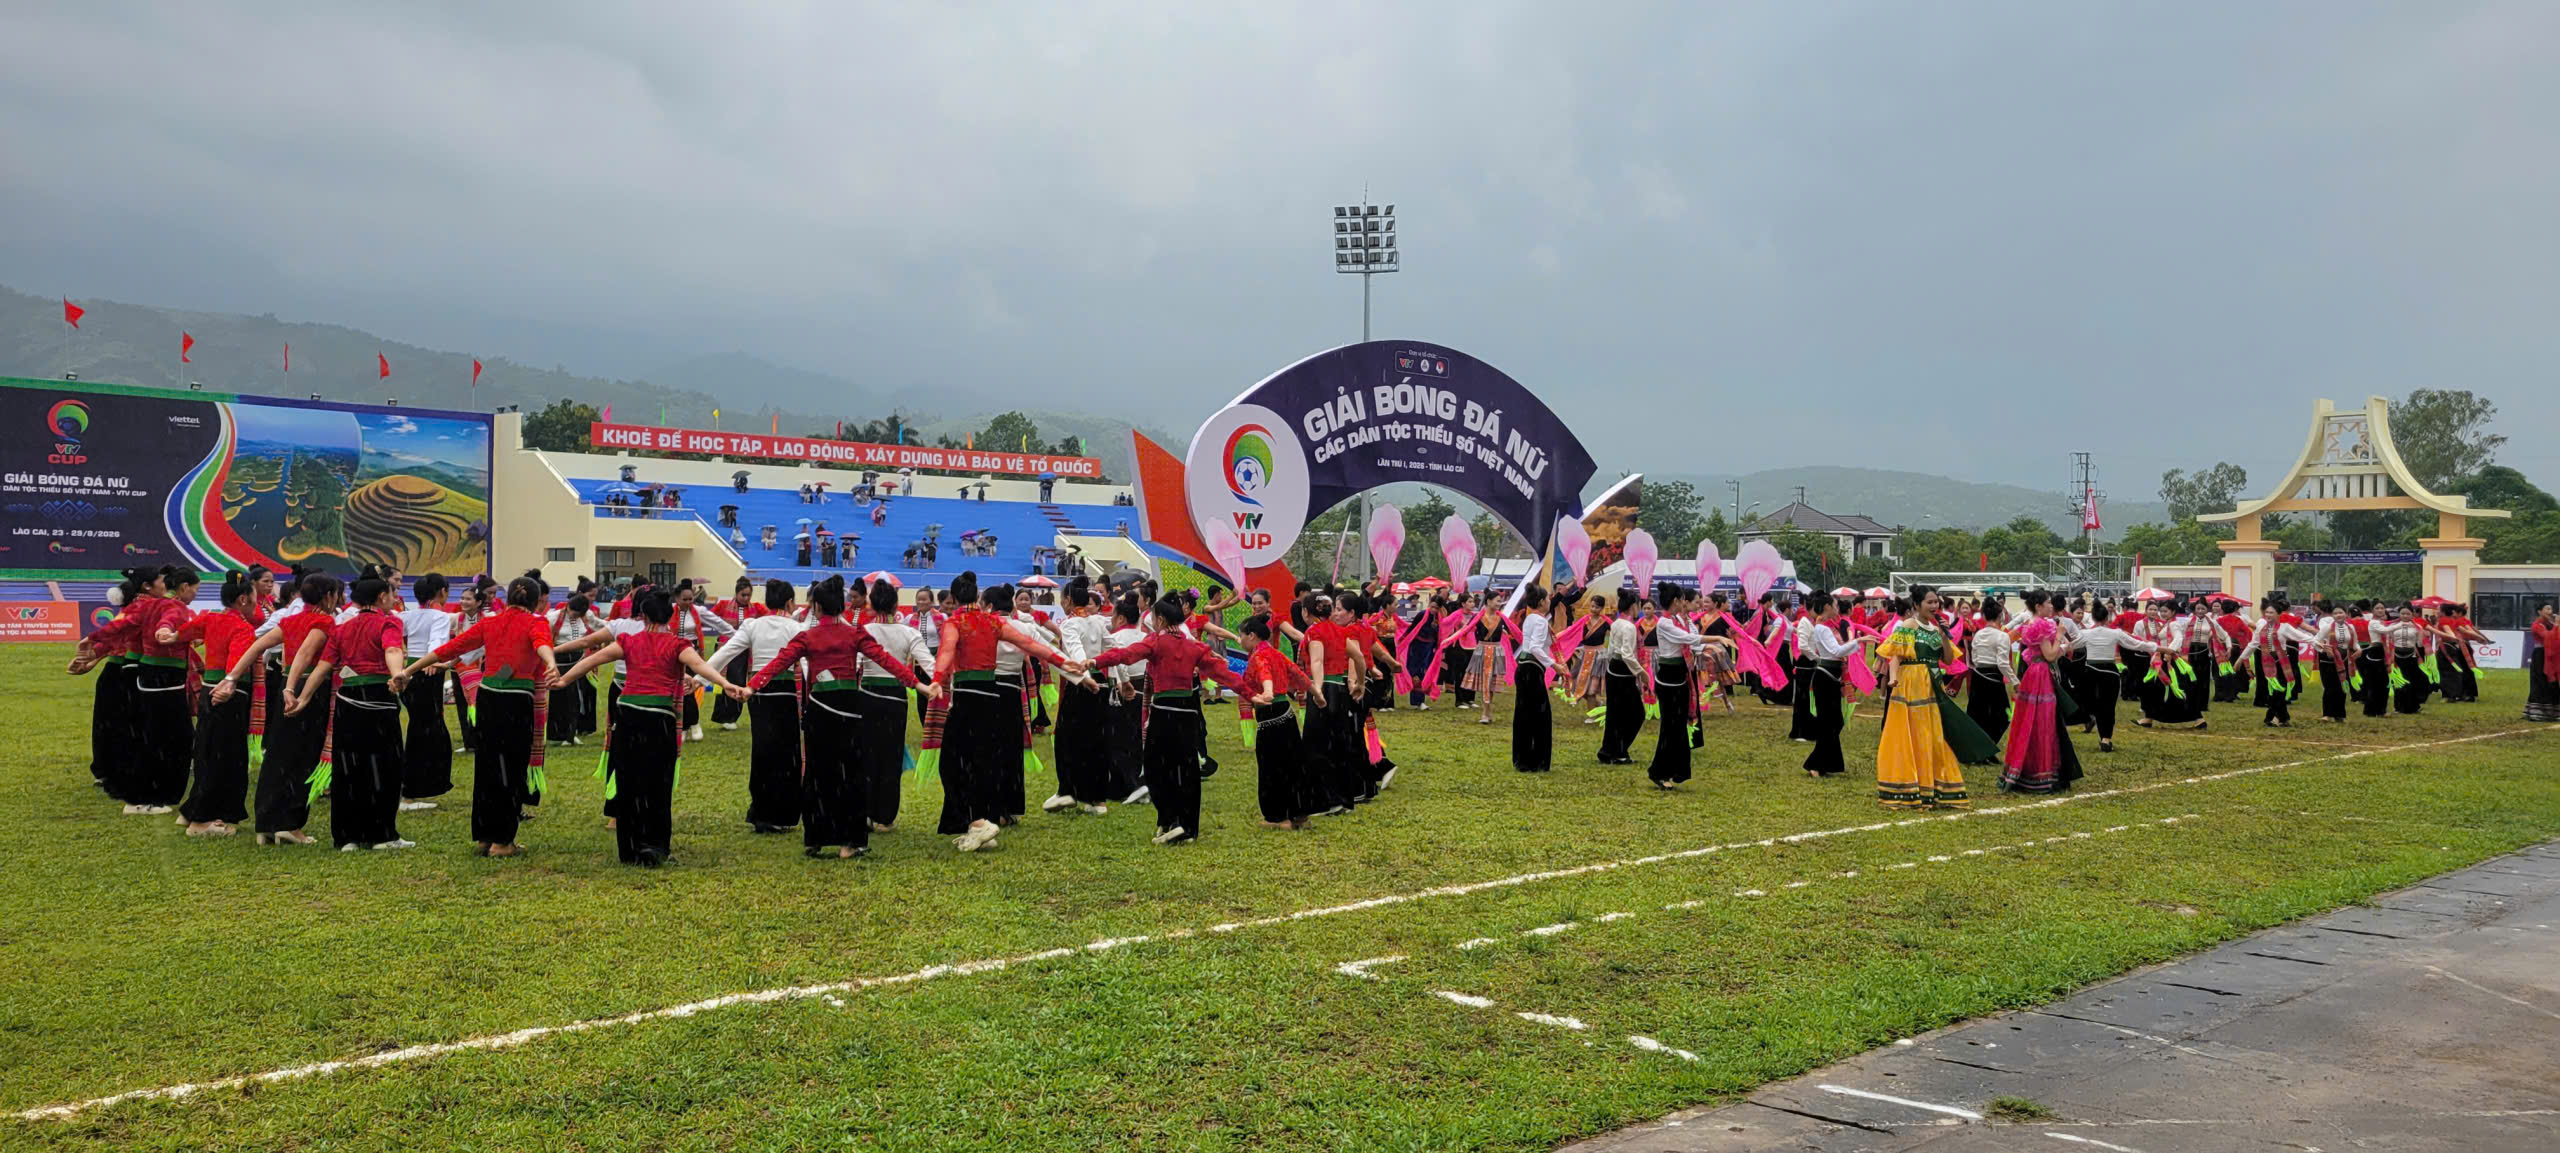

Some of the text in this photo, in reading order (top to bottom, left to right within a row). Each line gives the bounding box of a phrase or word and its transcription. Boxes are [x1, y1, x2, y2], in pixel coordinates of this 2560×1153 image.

[169, 416, 200, 424] viettel
[1303, 377, 1549, 480] GIẢI BÓNG ĐÁ NỮ
[55, 443, 80, 454] VTV
[602, 428, 1092, 475] KHOẺ ĐỂ HỌC TẬP, LAO ĐỘNG, XÂY DỰNG VÀ BẢO VỆ TỔ QUỐC
[48, 454, 88, 464] CUP
[1314, 420, 1534, 500] CÁC DÂN TỘC THIỂU SỐ VIỆT NAM
[4, 471, 129, 488] GIẢI BÓNG ĐÁ NỮ
[1232, 511, 1263, 530] VTV
[13, 527, 30, 535] LÀO
[1233, 531, 1272, 550] UP
[2478, 645, 2503, 657] Cai
